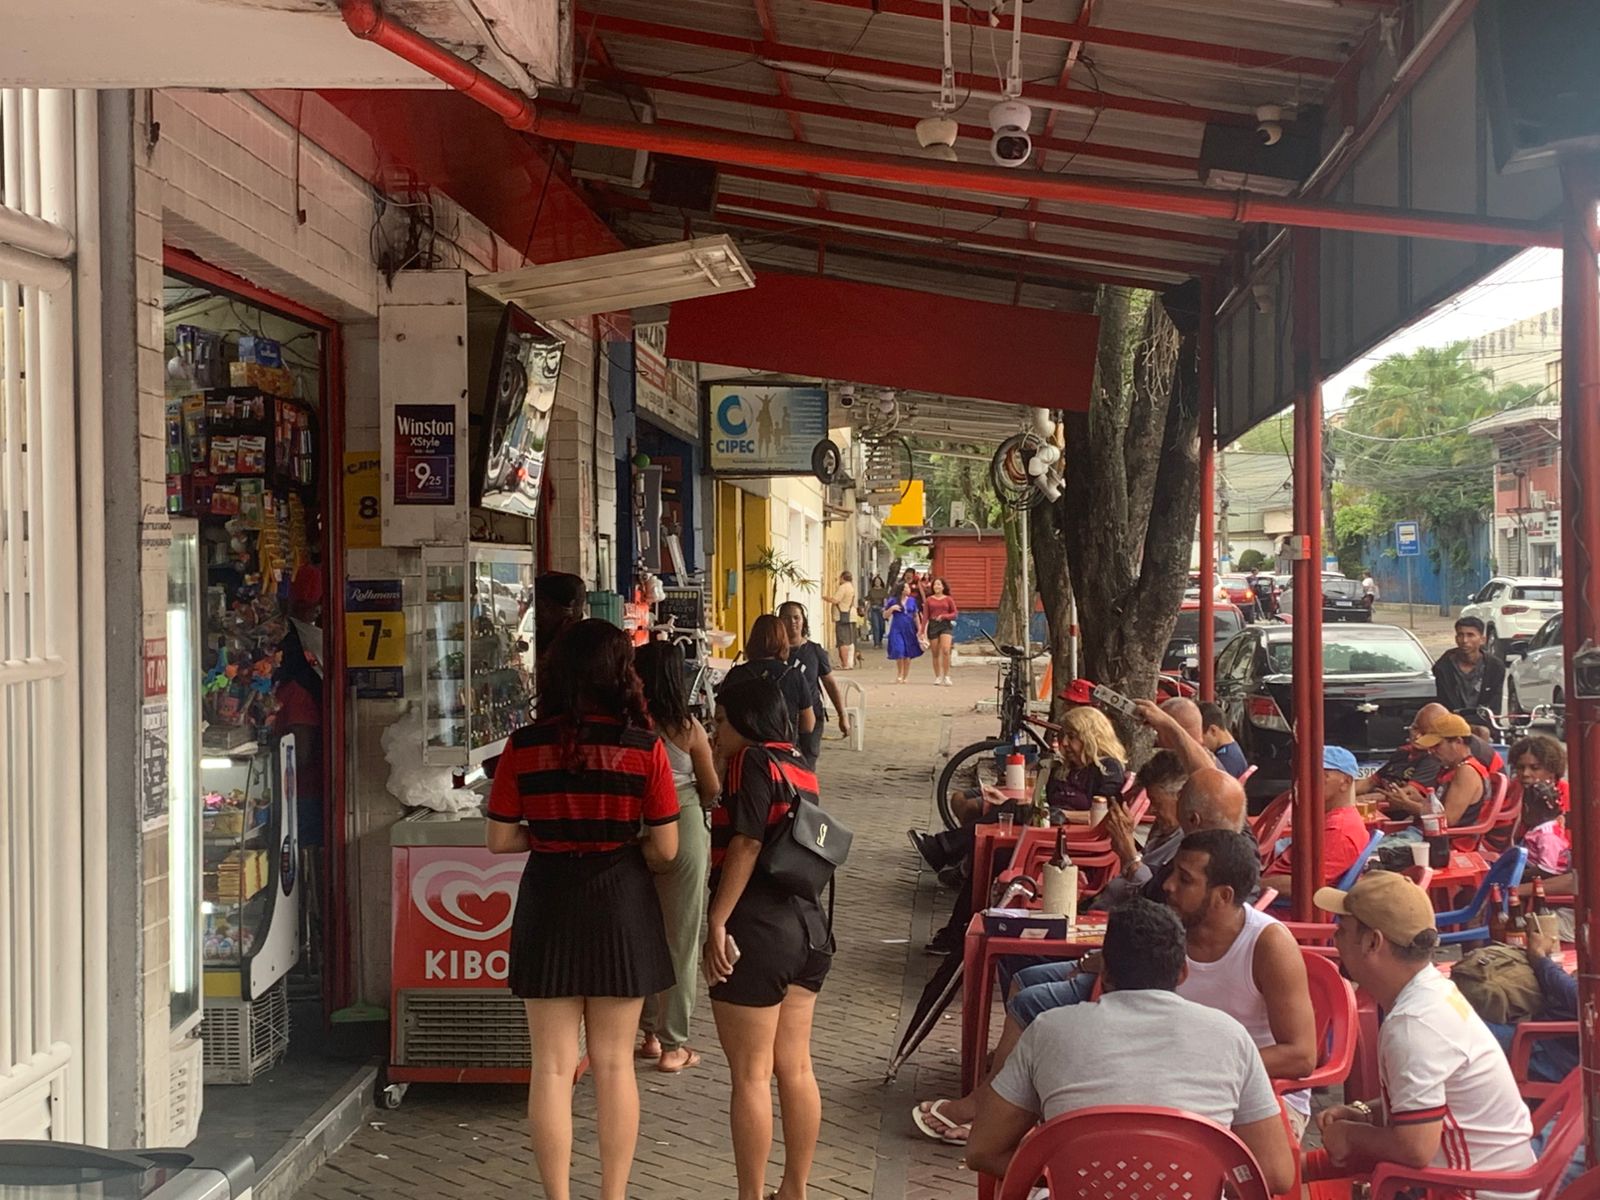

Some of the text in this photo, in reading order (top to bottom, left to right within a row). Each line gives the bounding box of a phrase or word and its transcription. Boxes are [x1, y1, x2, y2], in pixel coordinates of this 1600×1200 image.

[397, 415, 454, 436] Winston
[410, 437, 440, 449] XStyle
[716, 440, 755, 453] CIPEC
[351, 588, 400, 601] Rothmans
[425, 949, 509, 980] KIBO
